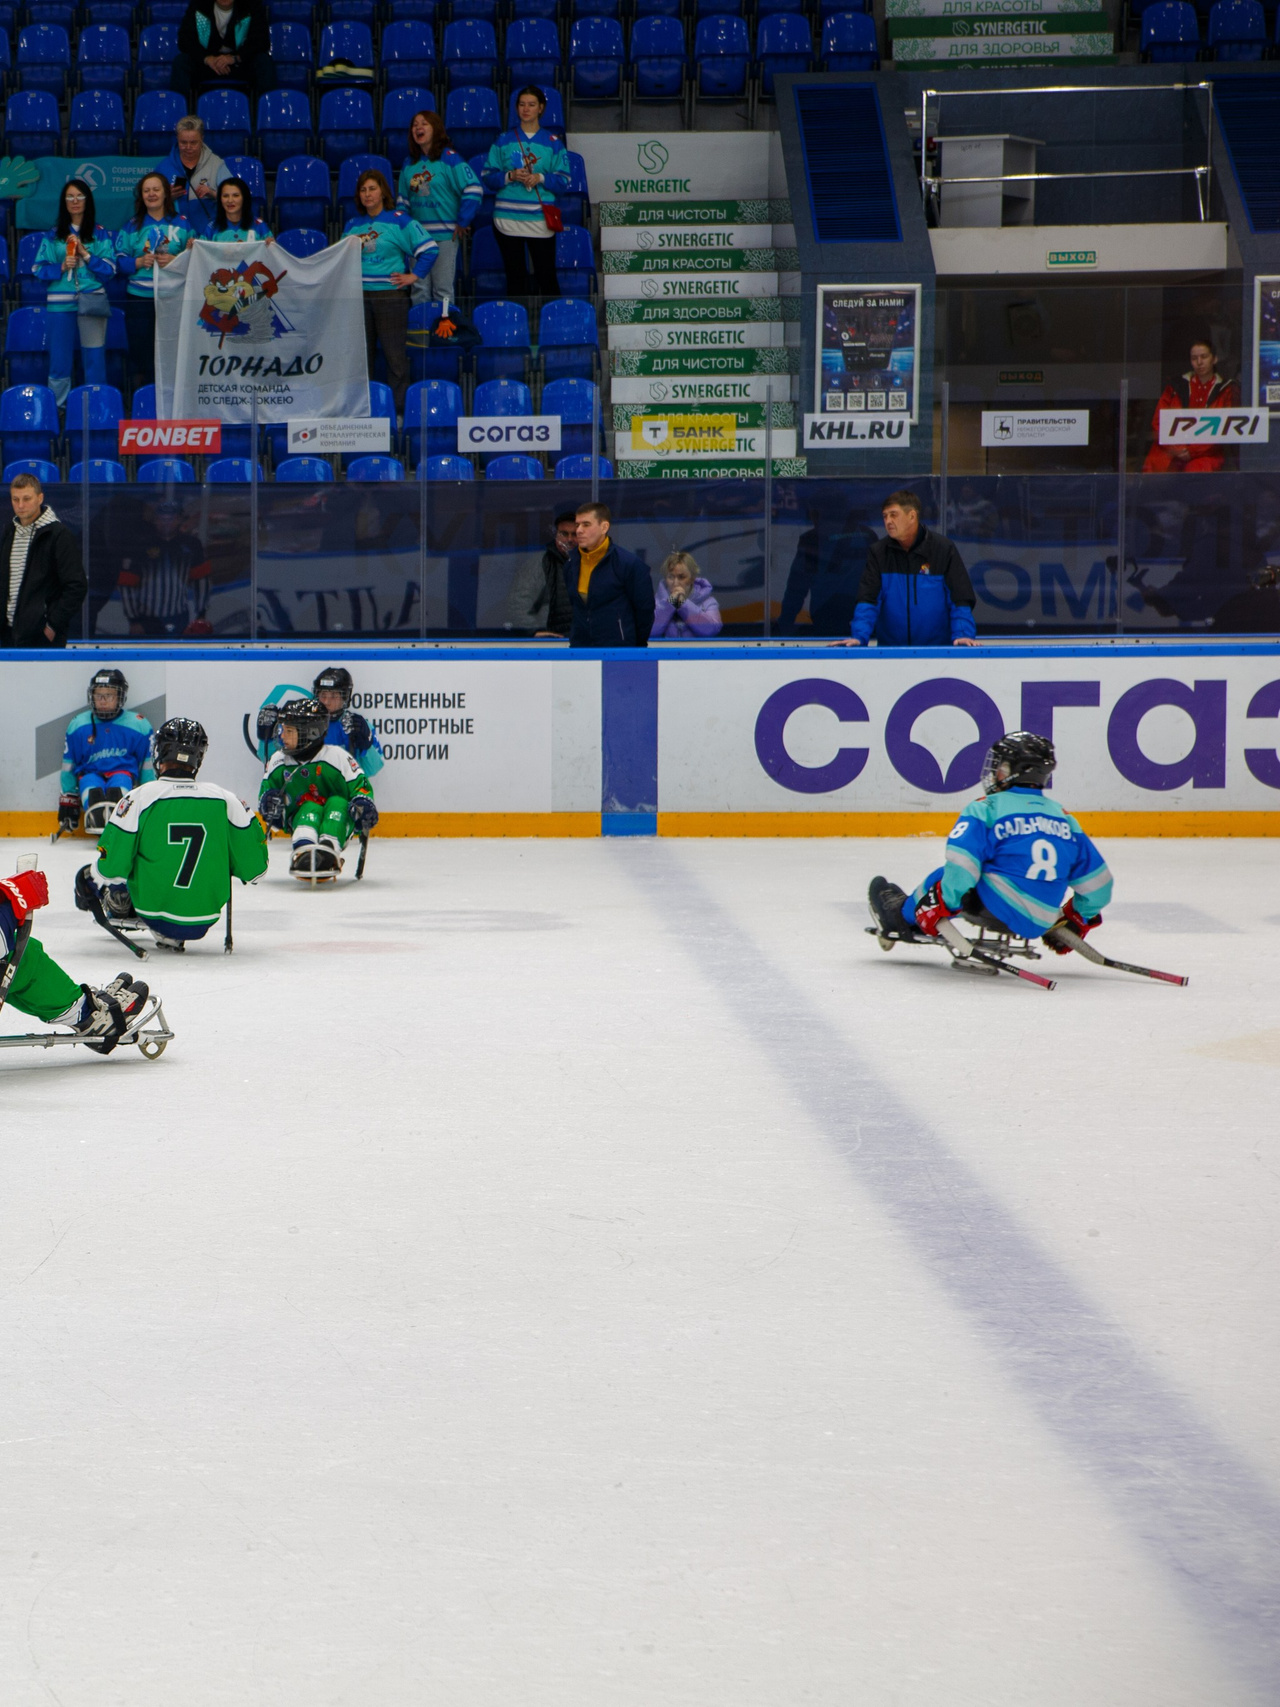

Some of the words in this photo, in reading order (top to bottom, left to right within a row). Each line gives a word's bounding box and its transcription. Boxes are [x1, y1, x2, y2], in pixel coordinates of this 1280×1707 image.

[942, 2, 971, 14] ДЛЯ
[975, 0, 1043, 12] КРАСОТЫ
[973, 21, 1047, 36] SYNERGETIC
[948, 44, 978, 57] ДЛЯ
[982, 41, 1060, 57] ЗДОРОВЬЯ
[112, 166, 154, 175] СОВРЕМЕН
[614, 179, 691, 194] SYNERGETIC
[638, 210, 664, 222] ДЛЯ
[668, 209, 727, 220] ЧИСТОТЫ
[658, 232, 734, 247] SYNERGETIC
[643, 259, 669, 271] ДЛЯ
[673, 258, 732, 269] КРАСОТЫ
[1050, 252, 1095, 263] ВЫХОД
[663, 280, 740, 295] SYNERGETIC
[833, 298, 864, 308] СЛЕДУЙ
[879, 299, 905, 307] НАМИ!
[643, 308, 669, 320] ДЛЯ
[673, 307, 742, 320] ЗДОРОВЬЯ
[667, 330, 745, 345] SYNERGETIC
[199, 352, 324, 377] ТОРНАДО
[652, 359, 679, 371] ДЛЯ
[683, 358, 745, 369] ЧИСТОТЫ
[198, 384, 238, 394] ДЕТСКАЯ
[240, 383, 290, 395] КОМАНДА
[672, 383, 751, 398] SYNERGETIC
[198, 397, 211, 405] ПО
[673, 426, 724, 438] БАНК
[809, 421, 905, 440] KHL.RU
[1169, 415, 1260, 436] PARI
[121, 427, 219, 447] FONBET
[320, 431, 386, 439] МЕТАЛЛУРГИЧЕСКАЯ
[676, 438, 756, 453] SYNERGETIC
[349, 692, 467, 710] ОВРЕМЕННЫЕ
[372, 718, 475, 735] НСПОРТНЫЕ
[383, 744, 449, 761] ОЛОГИИ
[949, 821, 970, 839] 8
[168, 823, 207, 889] 7
[1025, 839, 1058, 881] 8
